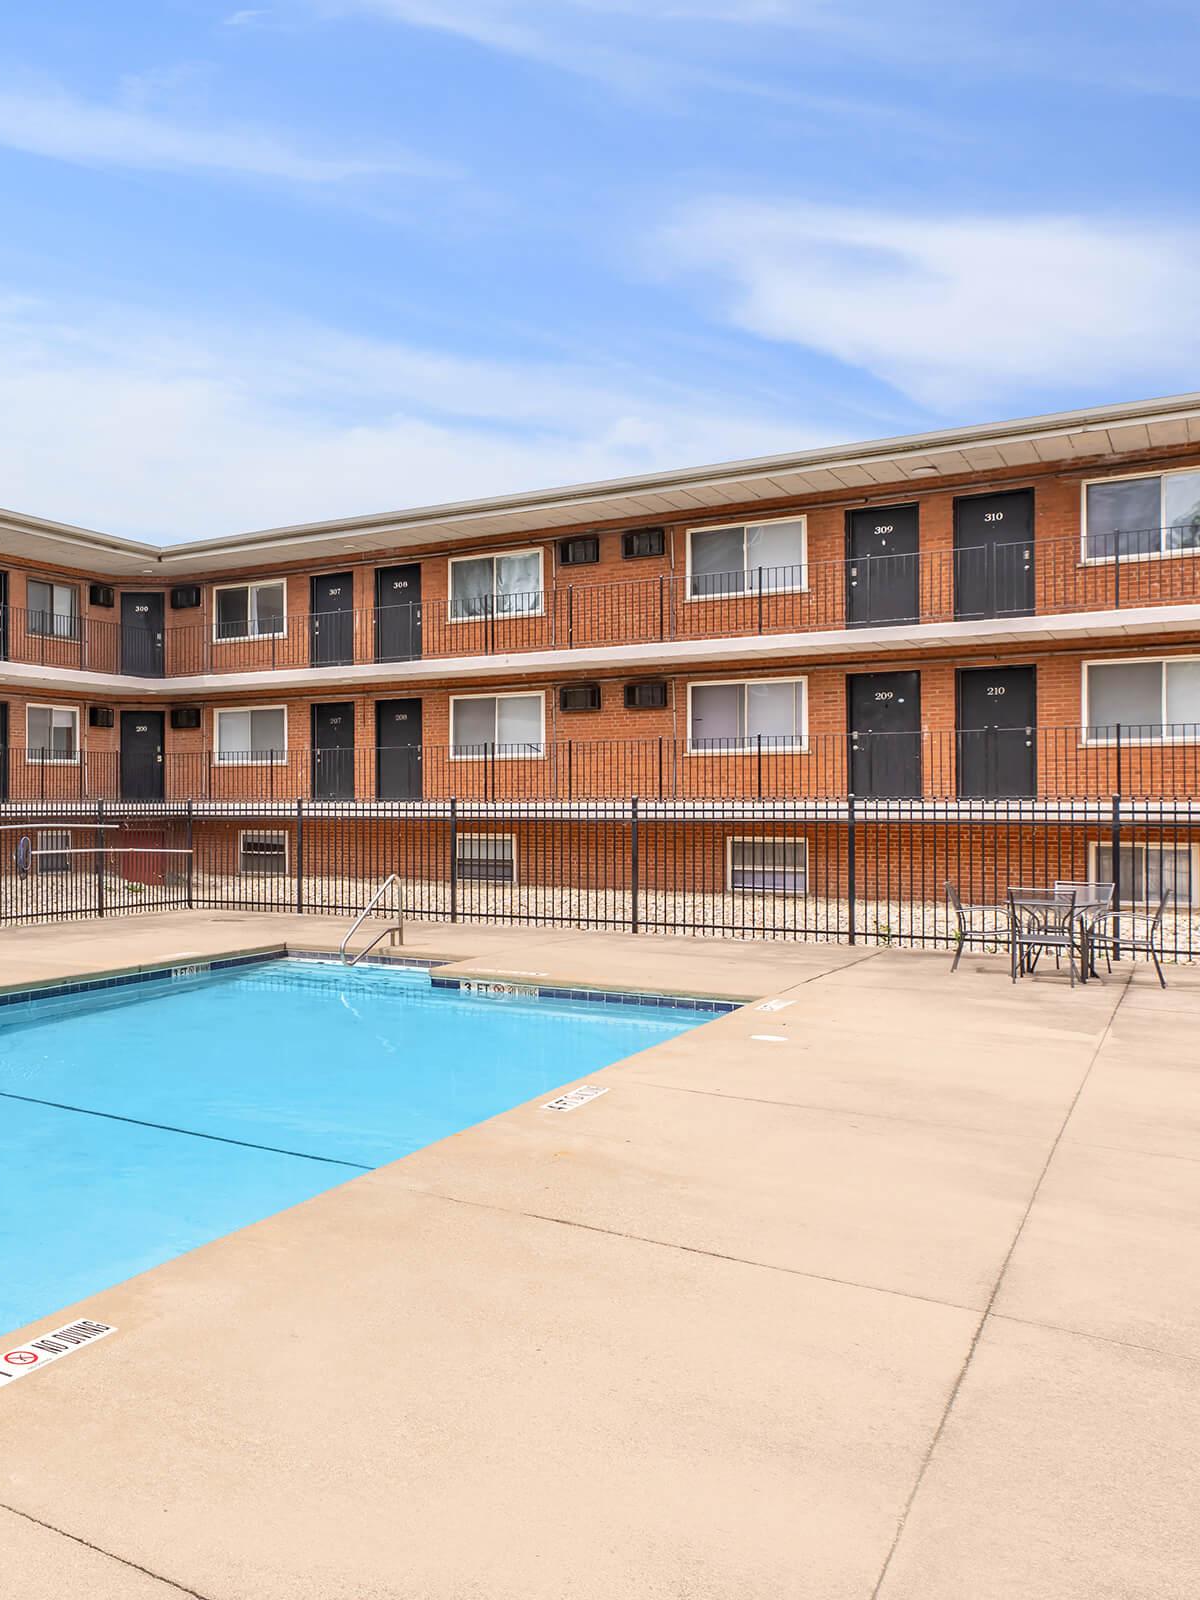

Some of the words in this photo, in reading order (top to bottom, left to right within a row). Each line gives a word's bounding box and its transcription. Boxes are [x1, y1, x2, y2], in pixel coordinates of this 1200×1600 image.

[984, 512, 1003, 522] 310
[874, 525, 893, 535] 309
[875, 692, 893, 700] 209
[987, 687, 1005, 696] 210
[477, 983, 490, 992] FT
[31, 1340, 69, 1354] NO
[52, 1321, 110, 1344] DIVING
